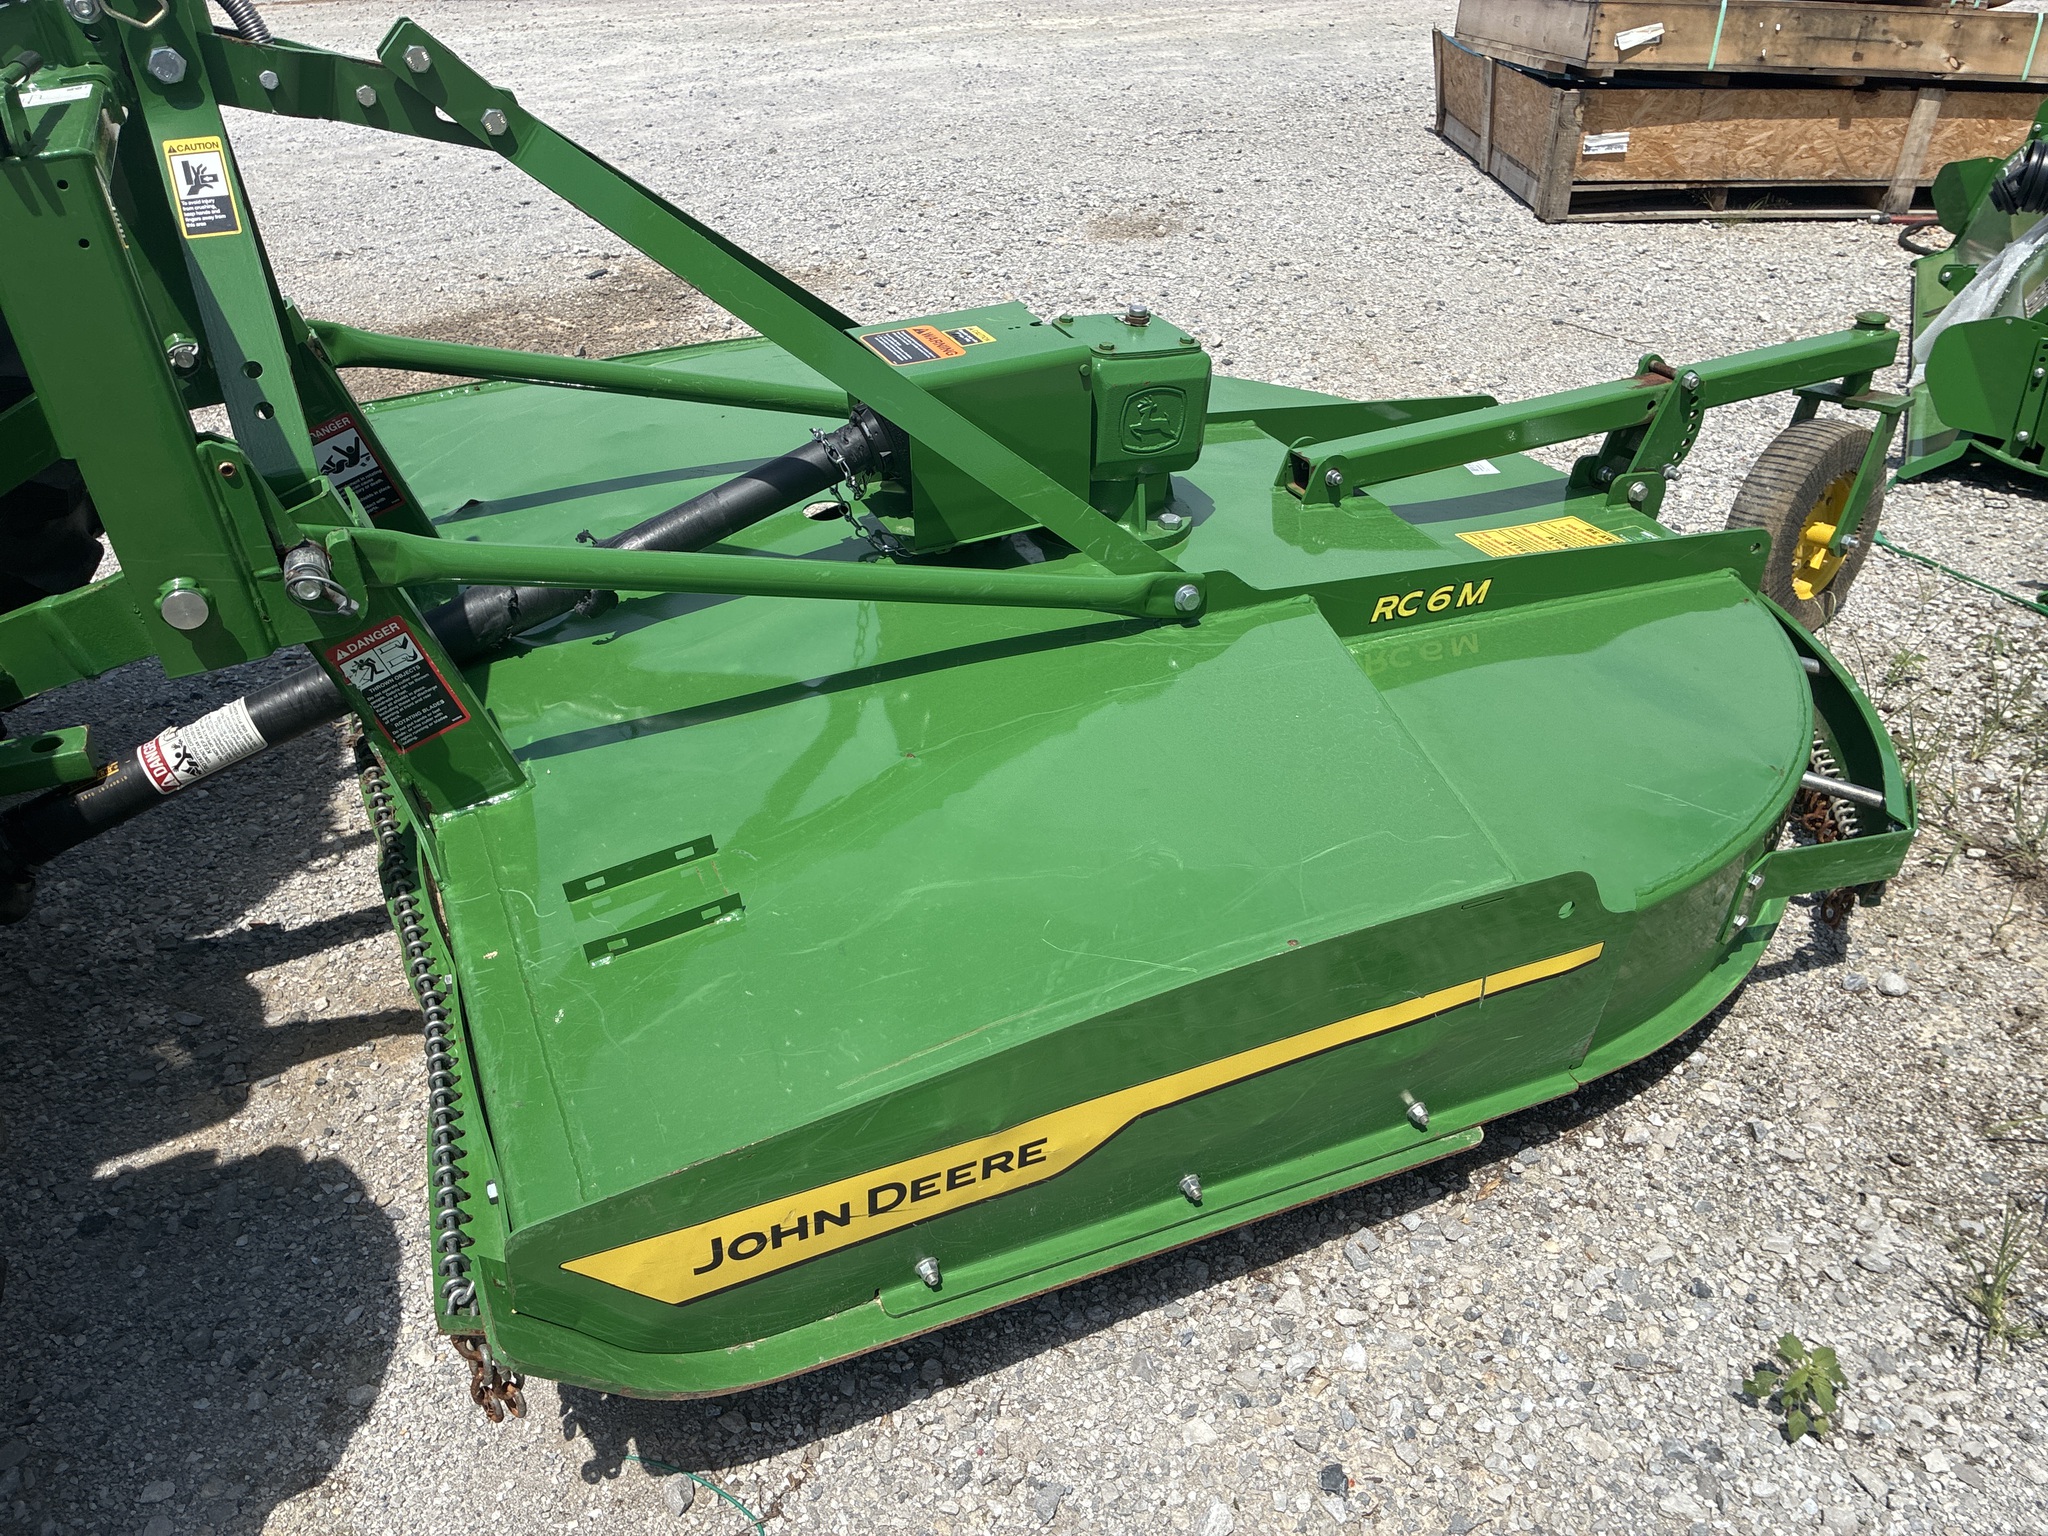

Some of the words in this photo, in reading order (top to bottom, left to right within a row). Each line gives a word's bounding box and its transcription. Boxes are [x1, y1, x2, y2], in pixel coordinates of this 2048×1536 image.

[177, 141, 219, 152] CAUTION
[922, 330, 958, 356] WARNING
[1506, 541, 1526, 552] ATTE
[1546, 536, 1570, 548] ATEN
[346, 622, 400, 654] DANGER
[368, 676, 395, 693] THROWN
[393, 663, 421, 681] OBJECTS
[393, 709, 422, 728] ROTATING
[421, 698, 445, 714] BLADES
[141, 739, 168, 777] DANGE
[693, 1201, 850, 1276] JOHN
[868, 1137, 1048, 1217] DEERE
